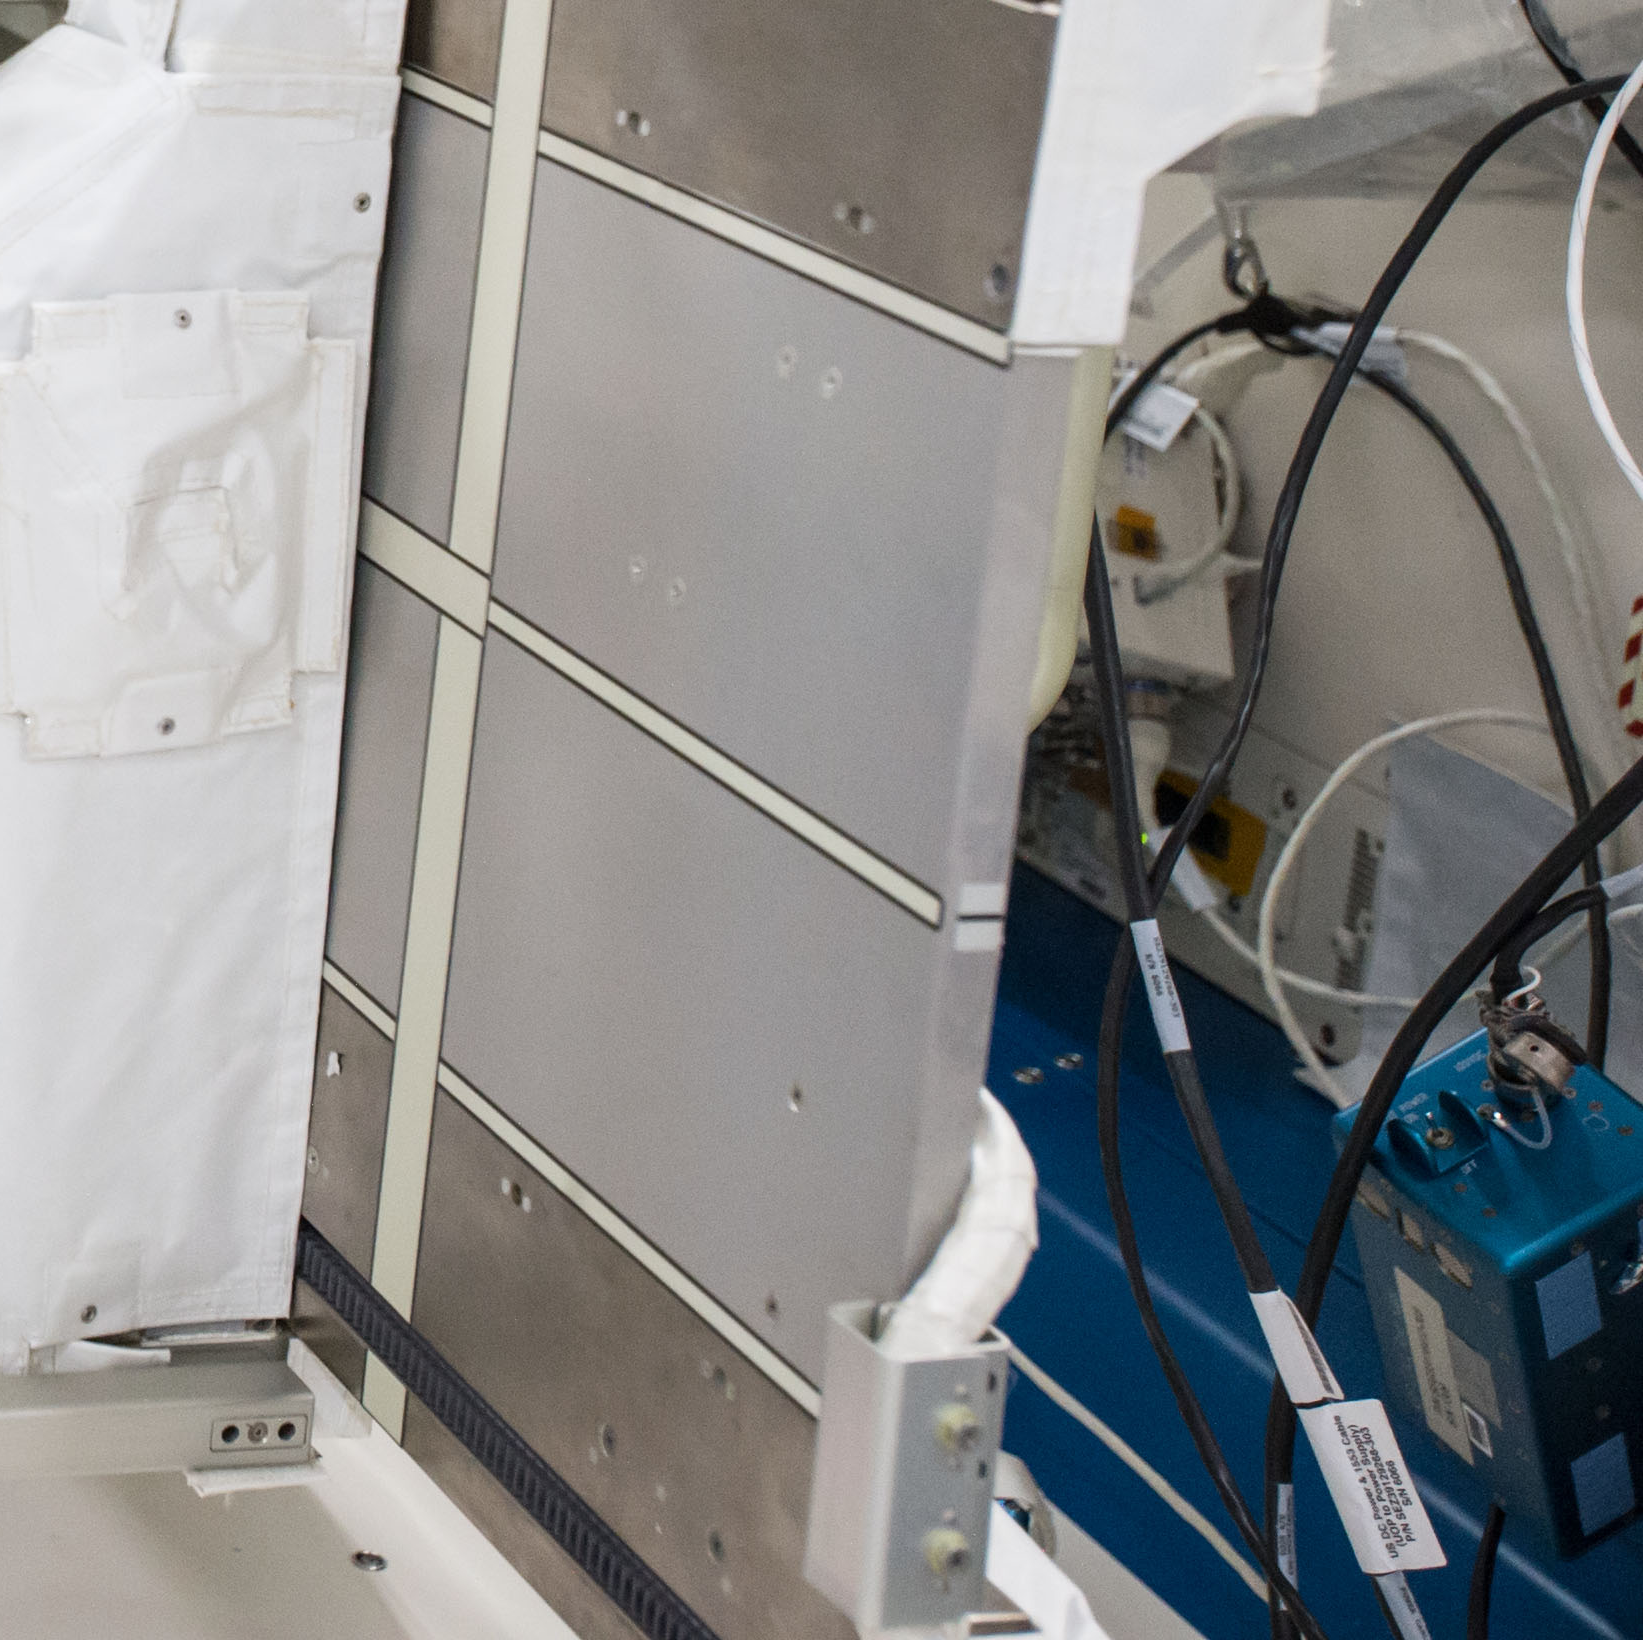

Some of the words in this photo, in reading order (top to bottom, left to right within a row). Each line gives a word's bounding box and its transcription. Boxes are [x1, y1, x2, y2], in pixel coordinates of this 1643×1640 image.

[1331, 1414, 1351, 1446] Cable
[1347, 1422, 1372, 1466] Supply)
[1345, 1447, 1362, 1473] 1553
[1358, 1475, 1367, 1485] &
[1366, 1467, 1386, 1503] Power
[1362, 1486, 1382, 1521] Power
[1396, 1486, 1412, 1507] S/N
[1381, 1504, 1392, 1516] to
[1376, 1522, 1390, 1541] DC
[1385, 1516, 1407, 1548] (UOP
[1400, 1521, 1415, 1543] P/N
[1385, 1541, 1398, 1559] US
